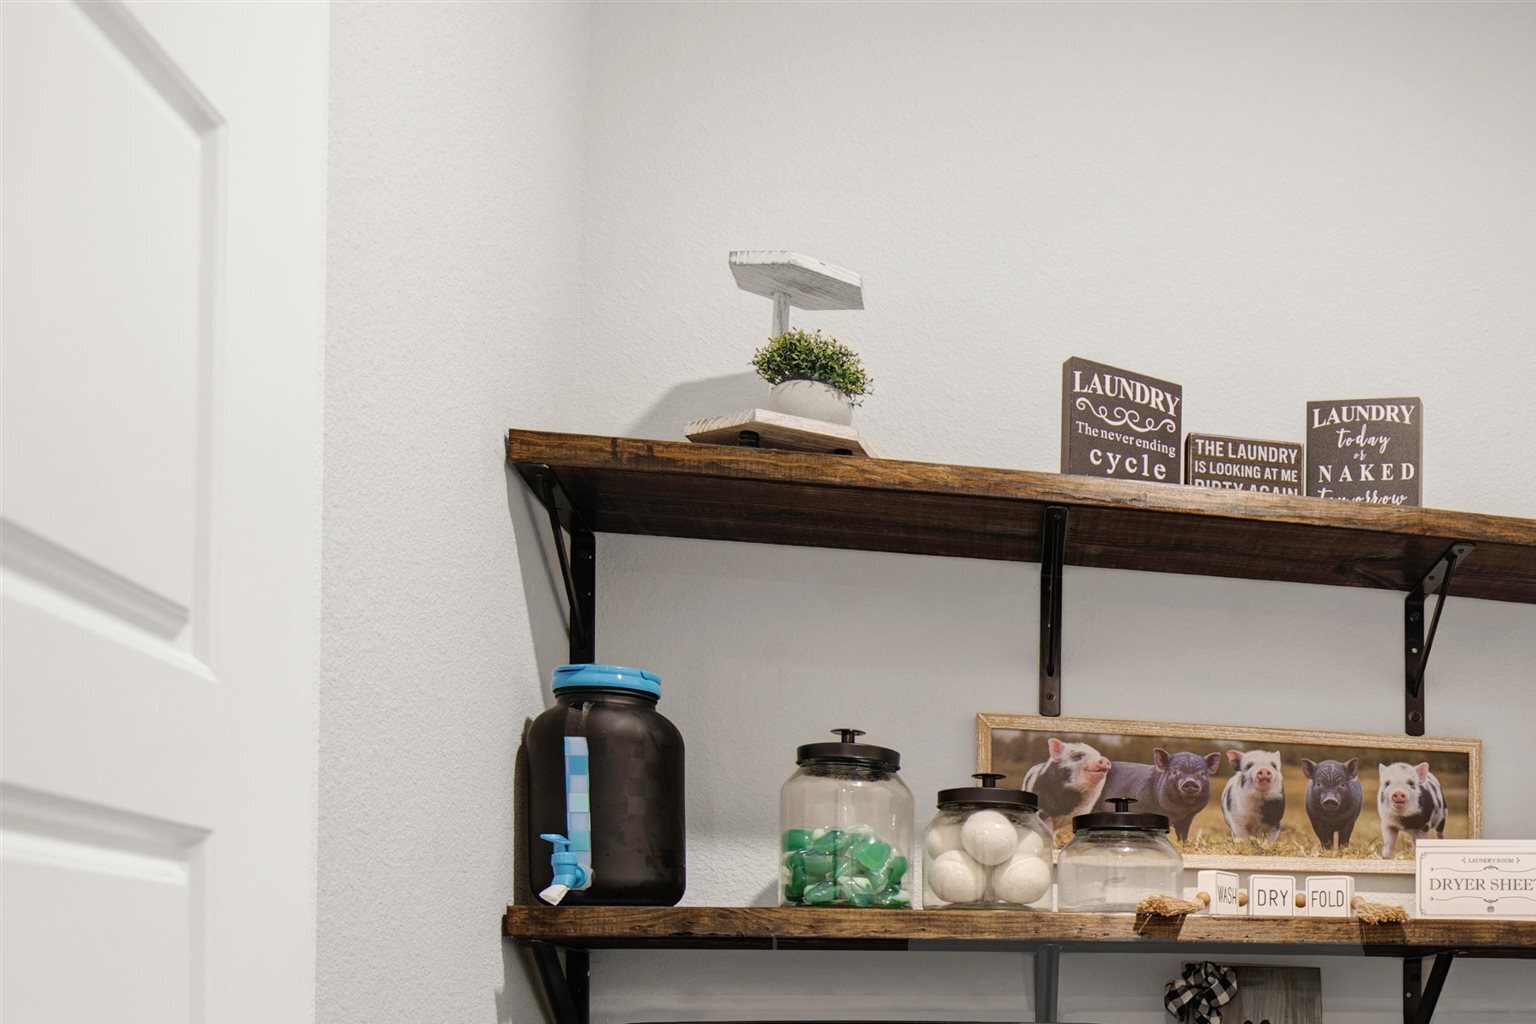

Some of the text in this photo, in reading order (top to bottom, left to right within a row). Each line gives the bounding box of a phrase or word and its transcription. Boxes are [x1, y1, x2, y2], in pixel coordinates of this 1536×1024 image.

[1073, 370, 1180, 417] LAUNDRY
[1312, 405, 1415, 429] LAUNDRY
[1075, 421, 1176, 458] The never ending
[1336, 424, 1391, 454] today
[1090, 448, 1166, 479] cycle
[1195, 439, 1298, 464] THE LAUNDRY
[1353, 449, 1366, 460] or
[1195, 460, 1298, 482] IS LOOKING AT ME
[1318, 463, 1415, 482] NAKED
[1218, 885, 1344, 908] WASH DRY FOLD
[1429, 878, 1486, 891] DRYER
